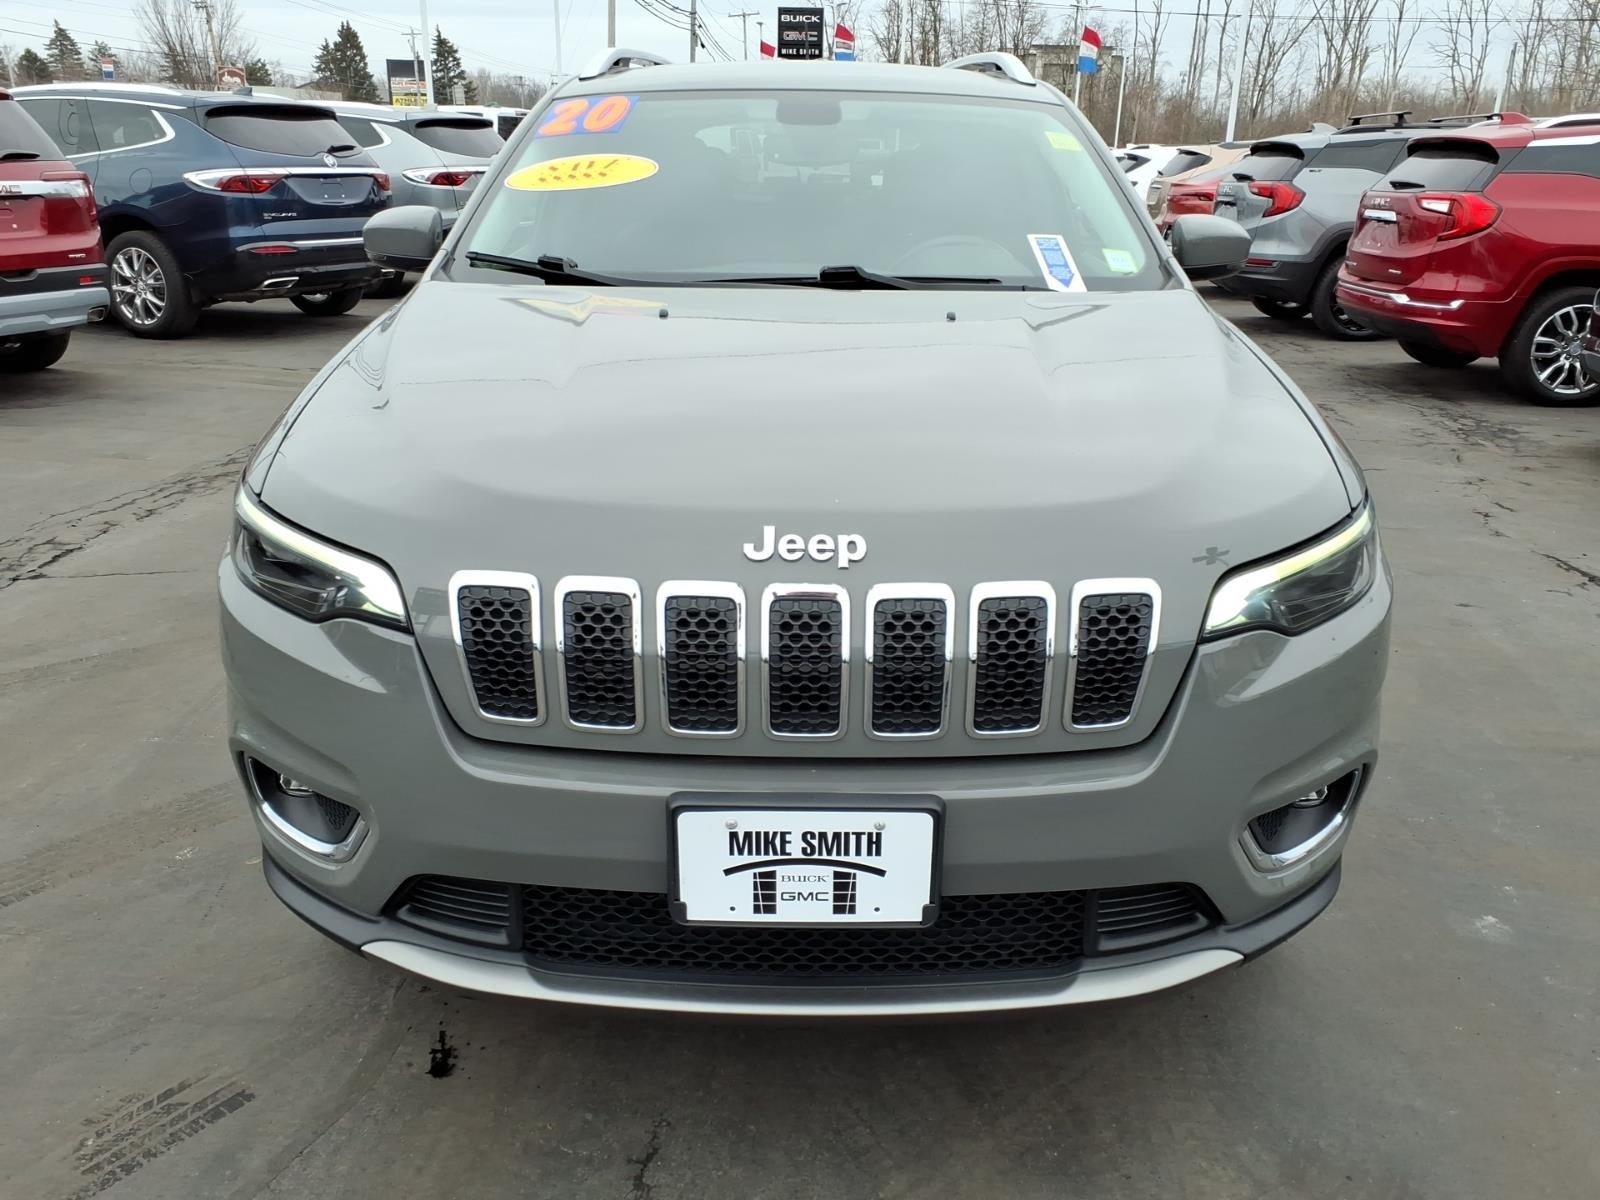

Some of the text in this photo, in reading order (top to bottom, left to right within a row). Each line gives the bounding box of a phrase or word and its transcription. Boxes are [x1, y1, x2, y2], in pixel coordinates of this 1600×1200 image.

[780, 14, 820, 23] BUICK
[783, 31, 818, 41] GMC
[537, 95, 630, 136] 20
[743, 525, 868, 570] Jeep
[728, 830, 882, 857] MIKE SMITH
[780, 874, 829, 884] BUICK
[780, 891, 829, 902] GMC
